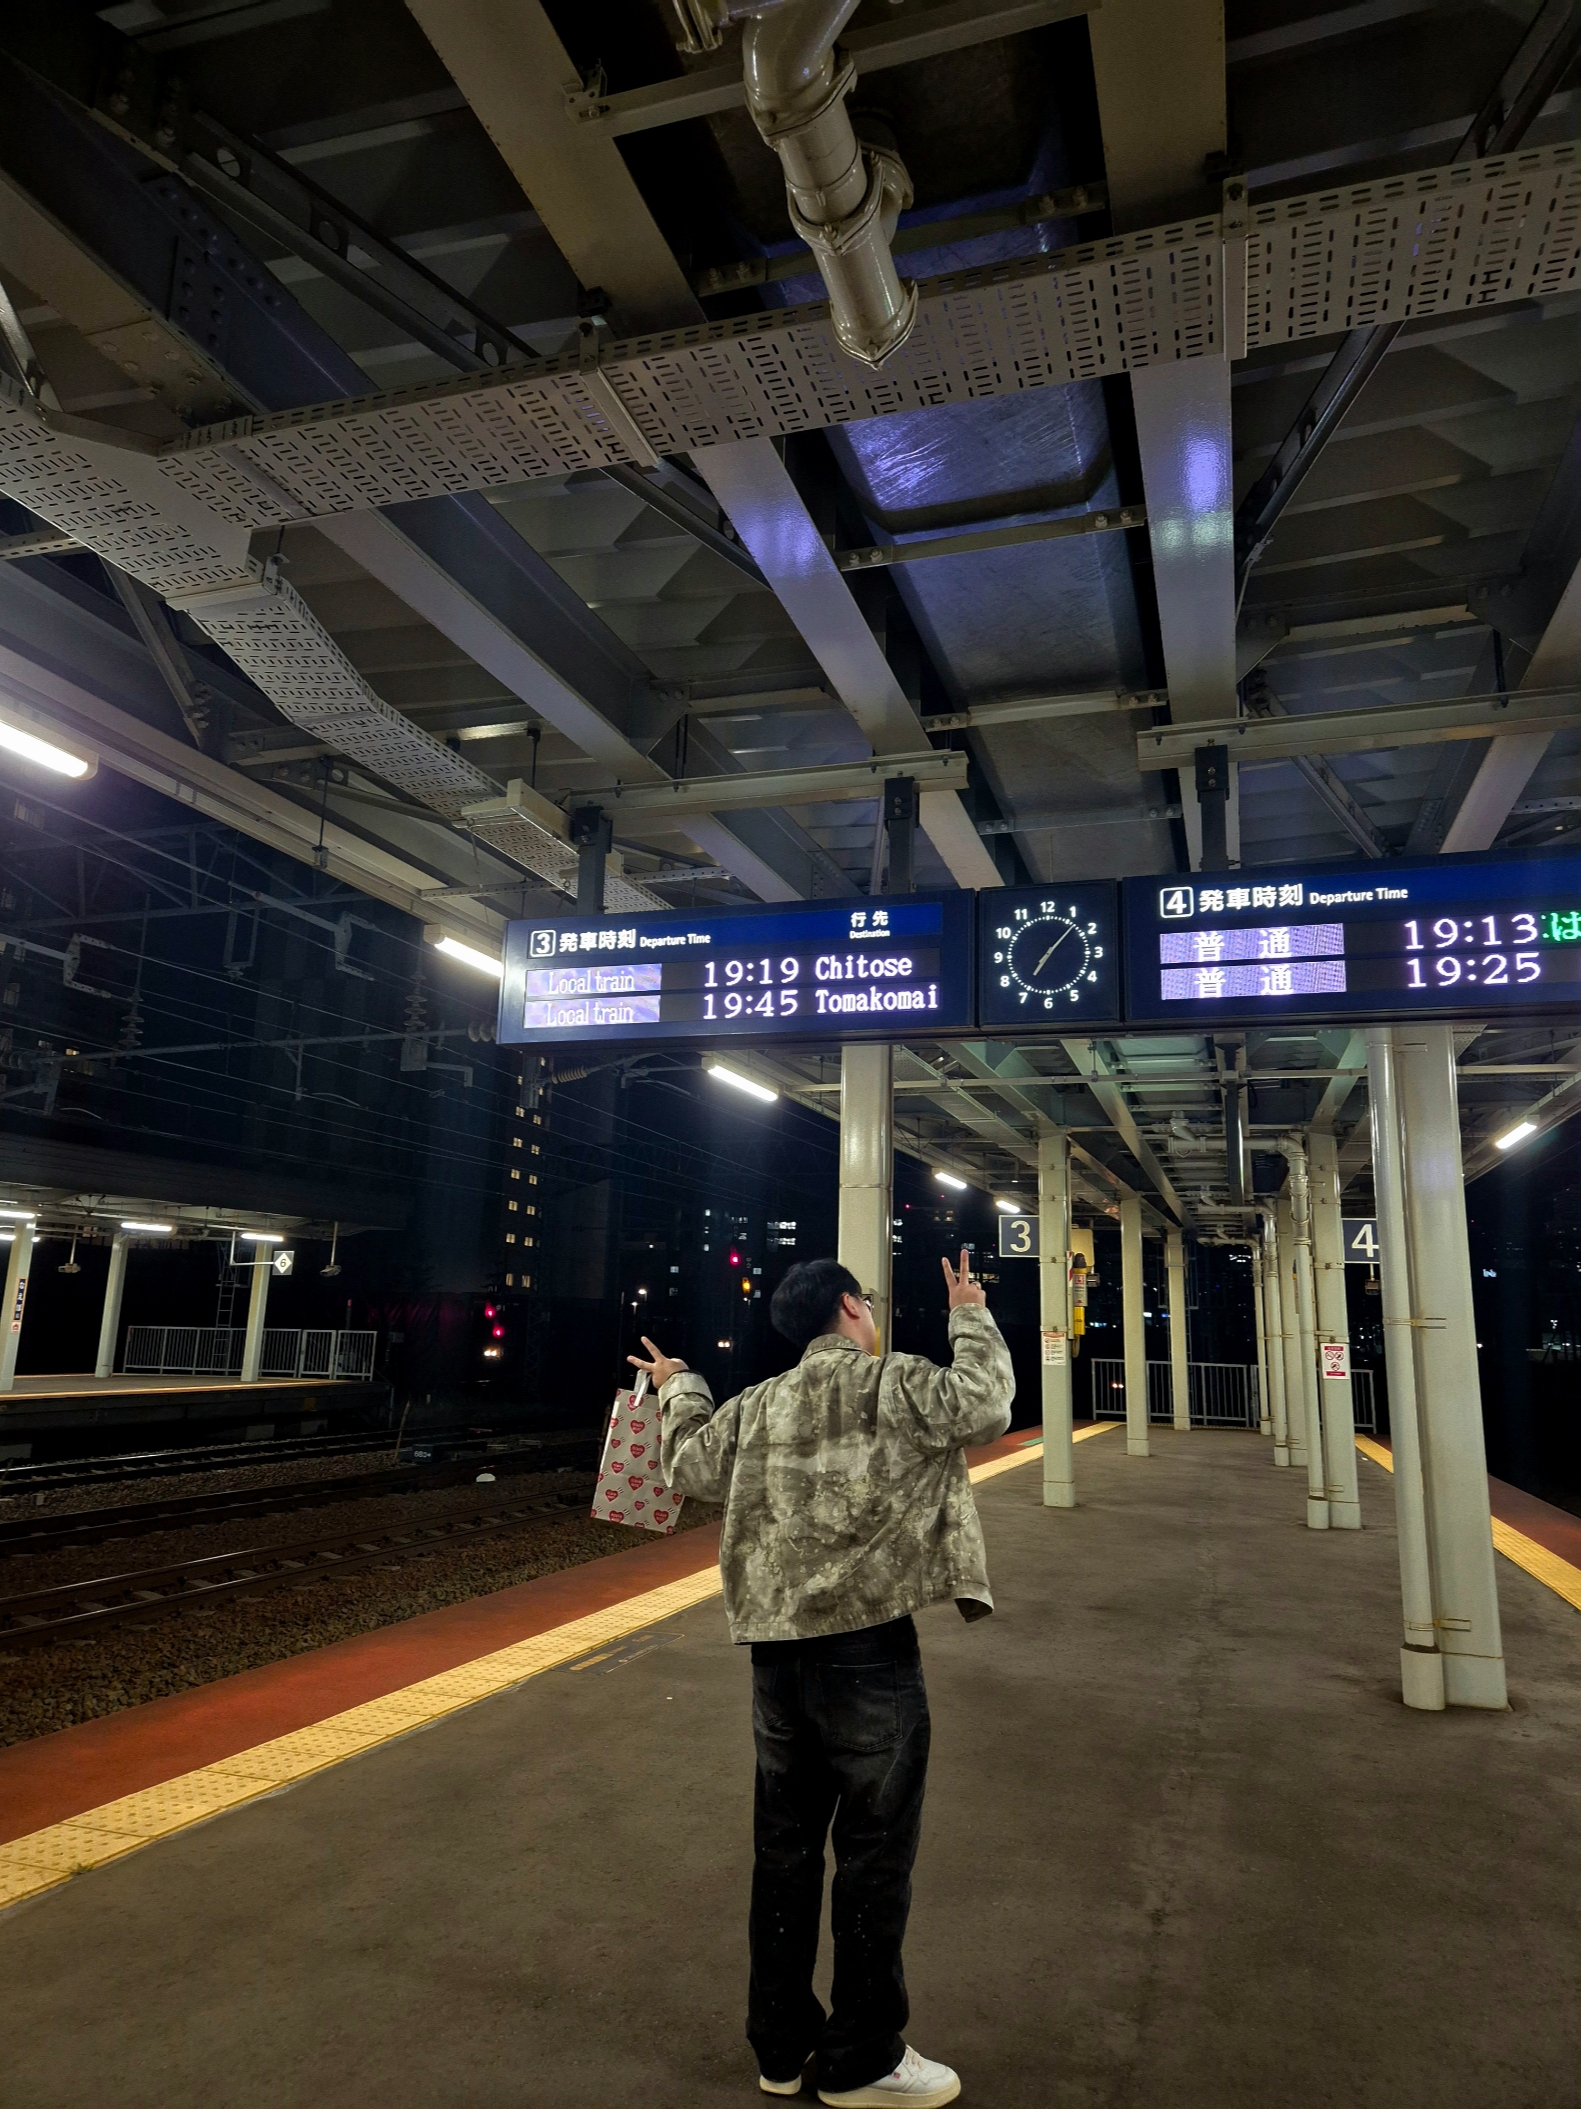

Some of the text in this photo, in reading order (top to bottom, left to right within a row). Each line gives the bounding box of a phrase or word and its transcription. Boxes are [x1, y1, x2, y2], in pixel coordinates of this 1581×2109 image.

[1166, 890, 1187, 914] 4
[1199, 883, 1303, 912] 発車時刻
[1309, 887, 1408, 906] Departure Time
[1014, 908, 1028, 920] 11
[1040, 901, 1055, 913] 12
[1069, 906, 1077, 918] 1
[850, 910, 889, 928] 行先
[1087, 922, 1097, 935] 2
[559, 929, 636, 952] 発車時刻
[849, 929, 891, 939] Destination
[996, 927, 1011, 939] 10
[1404, 913, 1538, 949] 19:13
[536, 932, 551, 954] 3
[640, 933, 711, 949] Departure Time
[1193, 927, 1292, 962] 普通
[994, 952, 1003, 963] 9
[1094, 946, 1104, 958] 3
[704, 957, 799, 987] 19:19
[815, 954, 912, 980] Chitose
[1087, 970, 1097, 982] 4
[1406, 951, 1541, 988] 19:25
[548, 970, 635, 995] Local train
[1000, 975, 1010, 987] 8
[1194, 964, 1294, 998] 普通
[703, 989, 798, 1019] 19:45
[815, 984, 938, 1013] Tomakomai
[1018, 992, 1028, 1004] 7
[1044, 997, 1053, 1009] 6
[1069, 989, 1079, 1002] 5
[546, 1002, 634, 1026] Local train
[1010, 1220, 1032, 1253] 3
[1351, 1223, 1380, 1258] 4
[279, 1258, 287, 1268] 6
